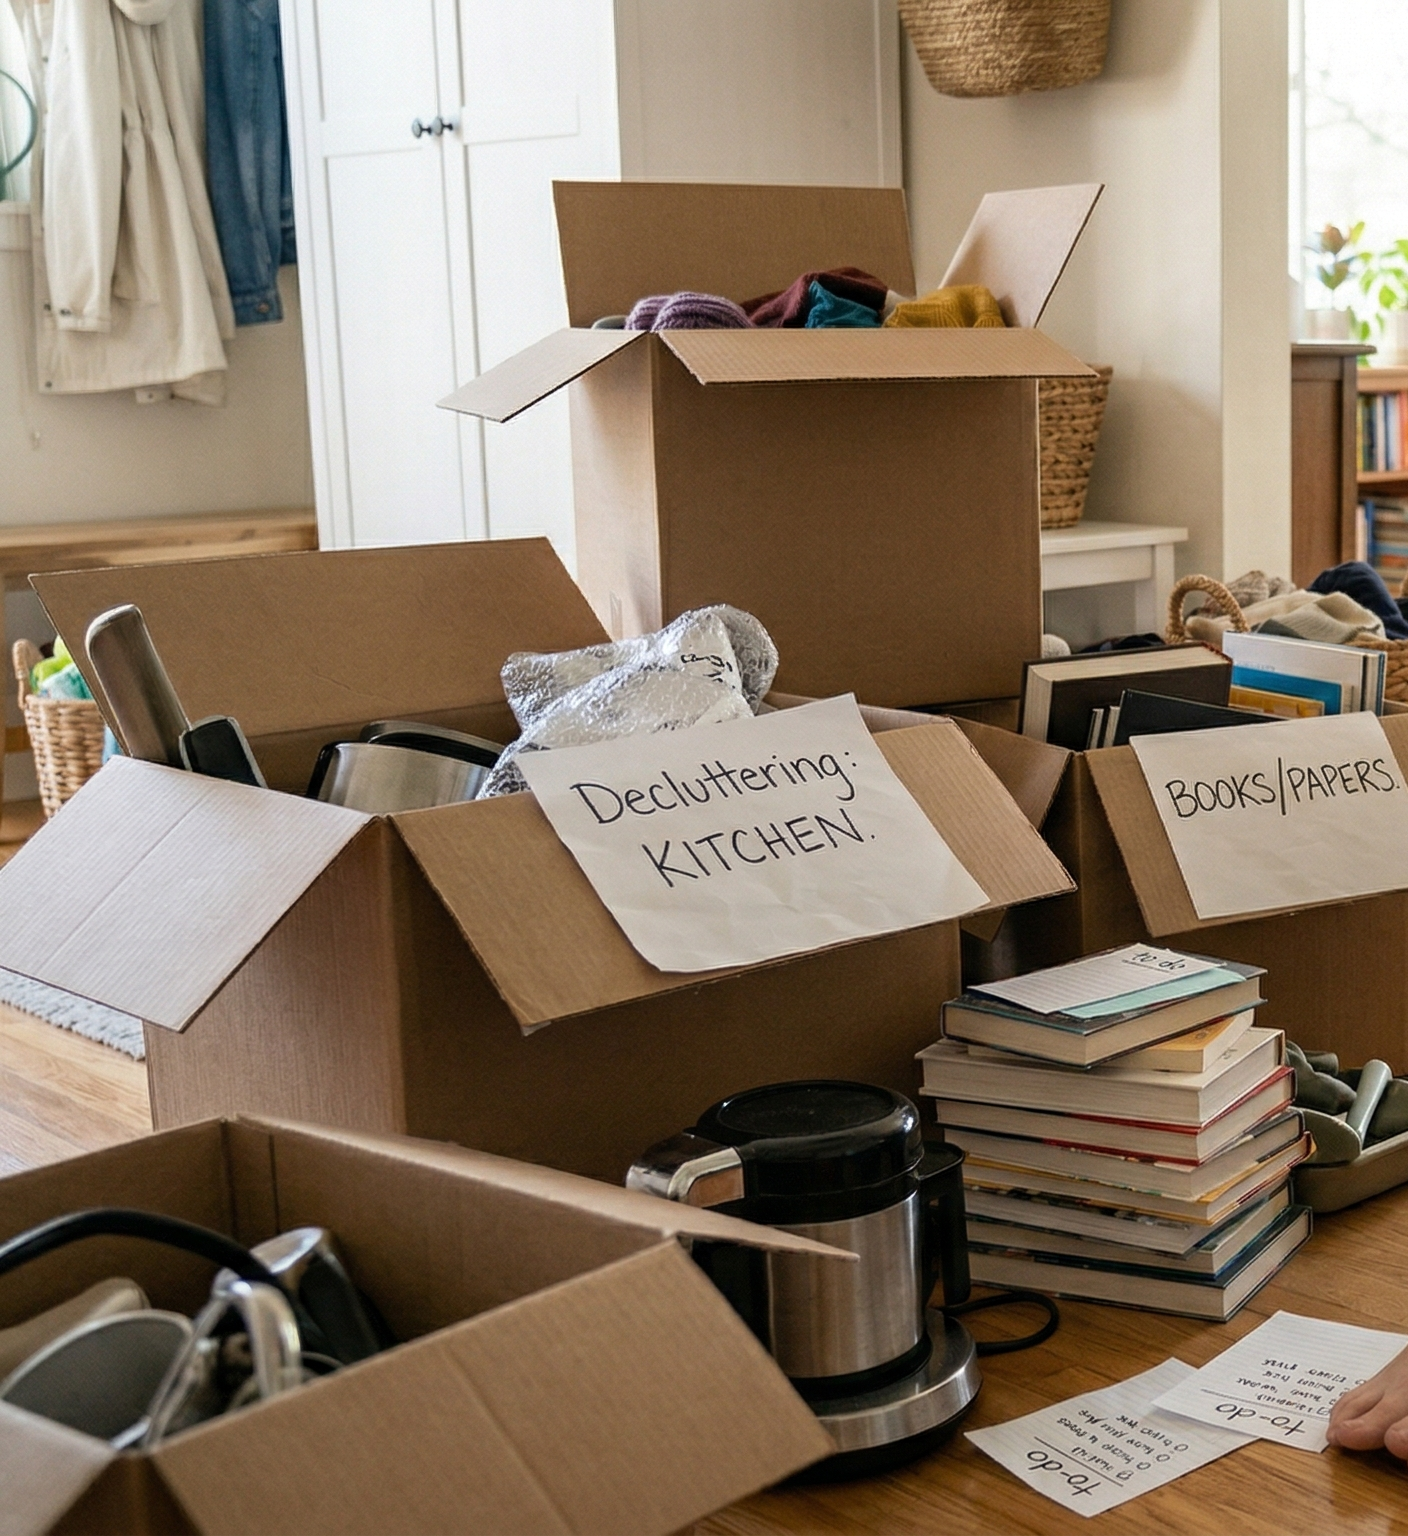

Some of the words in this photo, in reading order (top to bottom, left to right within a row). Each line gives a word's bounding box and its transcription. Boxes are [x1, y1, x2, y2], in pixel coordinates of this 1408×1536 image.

[571, 751, 857, 824] Decluttering:
[1165, 757, 1400, 818] BOOKS/PAPERS.
[641, 808, 876, 888] KITCHEN.
[1215, 1403, 1305, 1436] to-do
[1027, 1450, 1101, 1496] to-do
